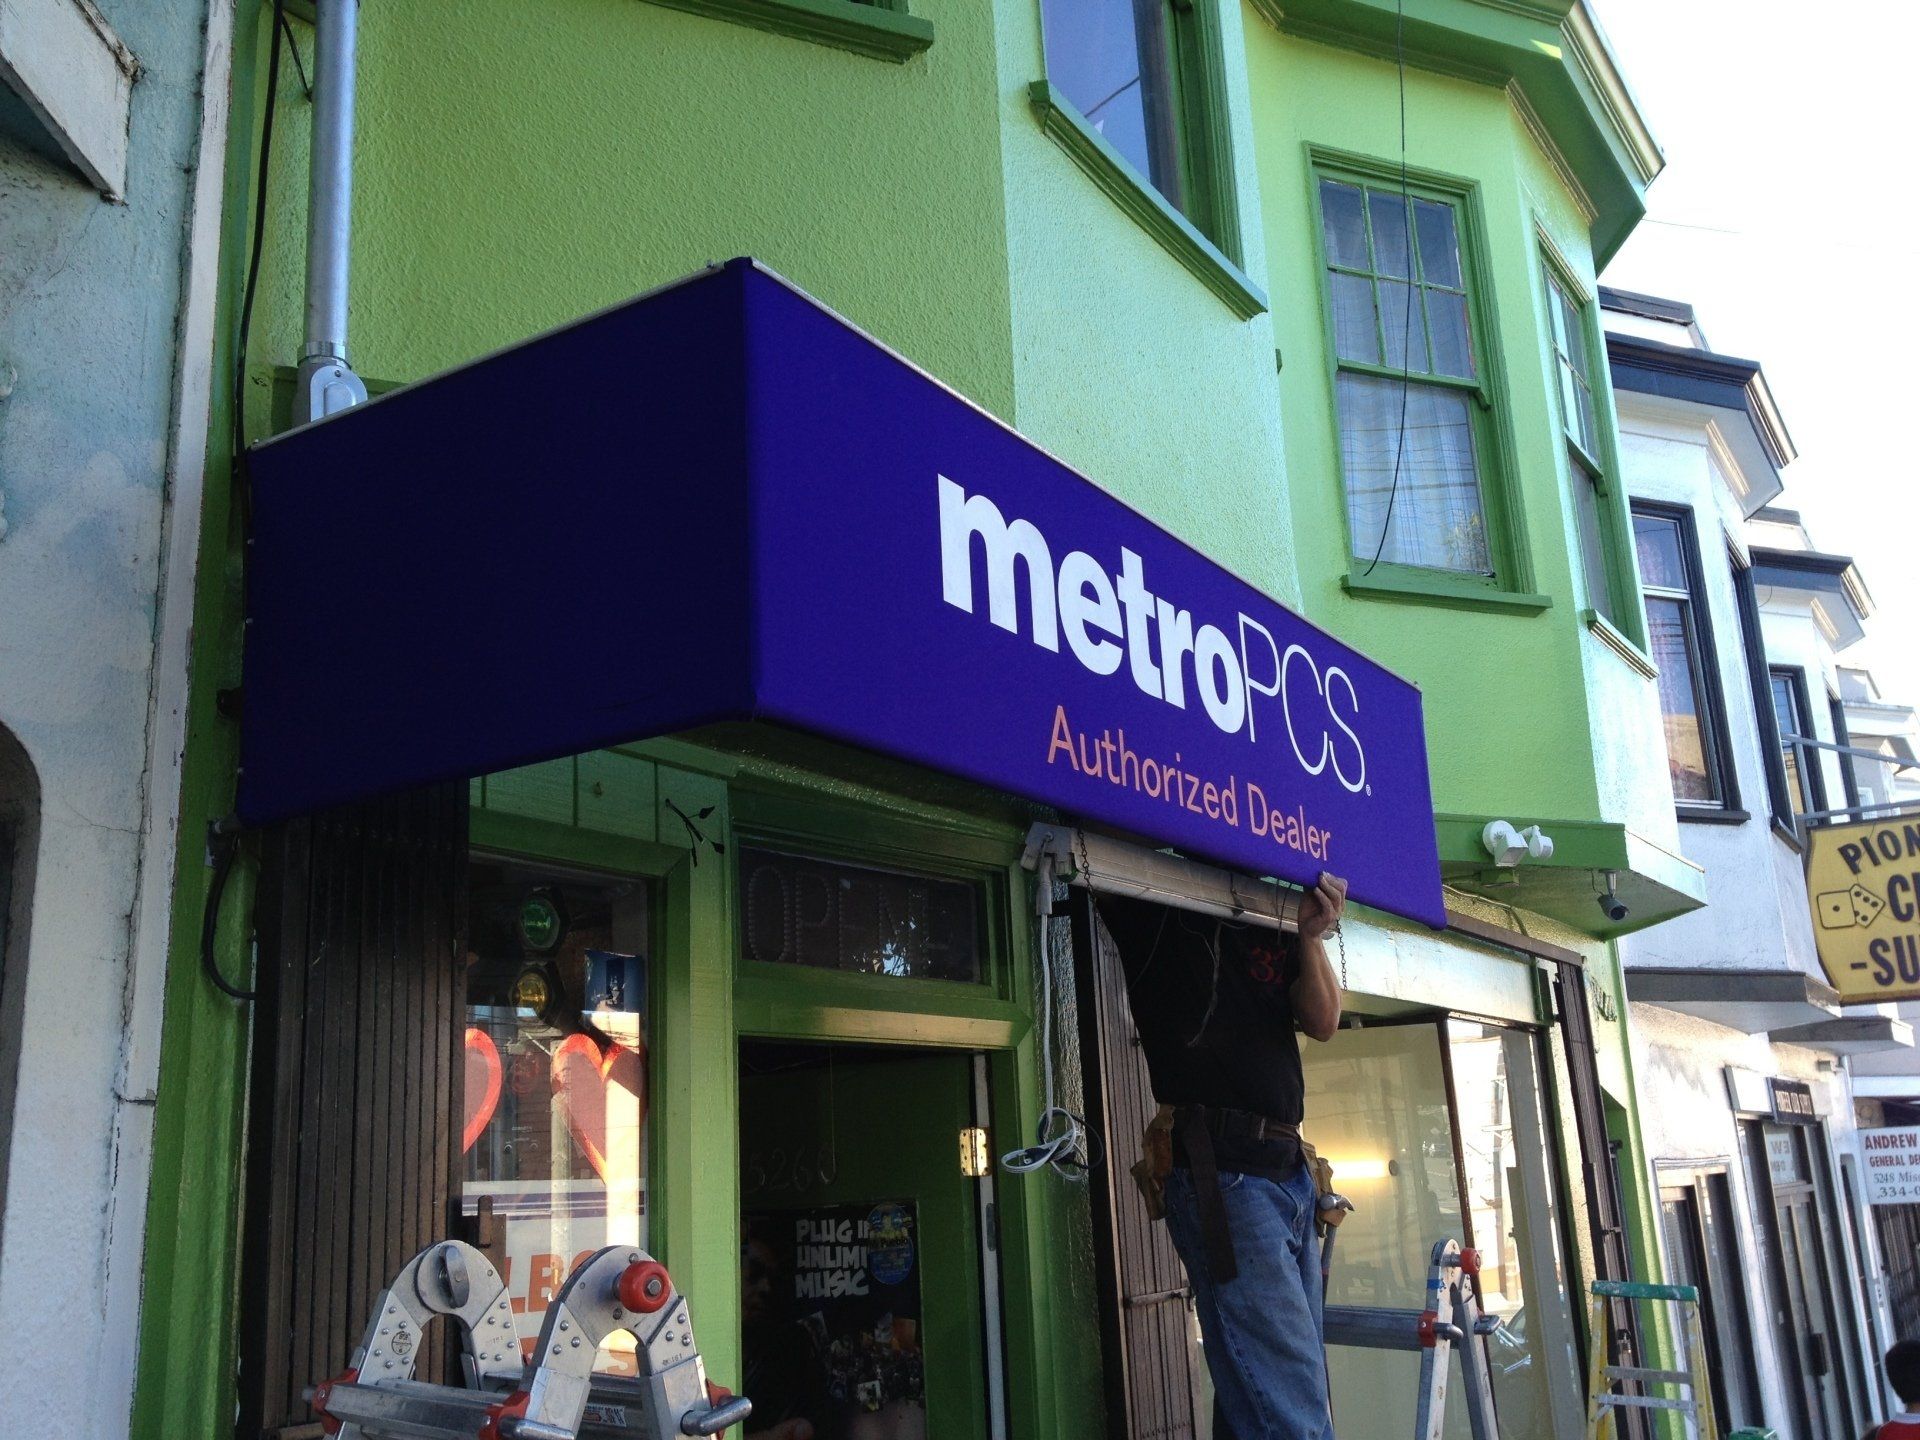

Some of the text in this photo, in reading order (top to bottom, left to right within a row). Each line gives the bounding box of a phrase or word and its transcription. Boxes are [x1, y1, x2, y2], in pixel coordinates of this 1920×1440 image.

[1047, 704, 1332, 862] Authorized Dealer
[1850, 934, 1920, 987] -SU
[1865, 1133, 1917, 1150] ANDREW
[1869, 1155, 1905, 1168] GENERAL
[796, 1218, 853, 1243] PLUG
[797, 1245, 868, 1268] UNLIMI
[795, 1269, 869, 1298] MUSIC
